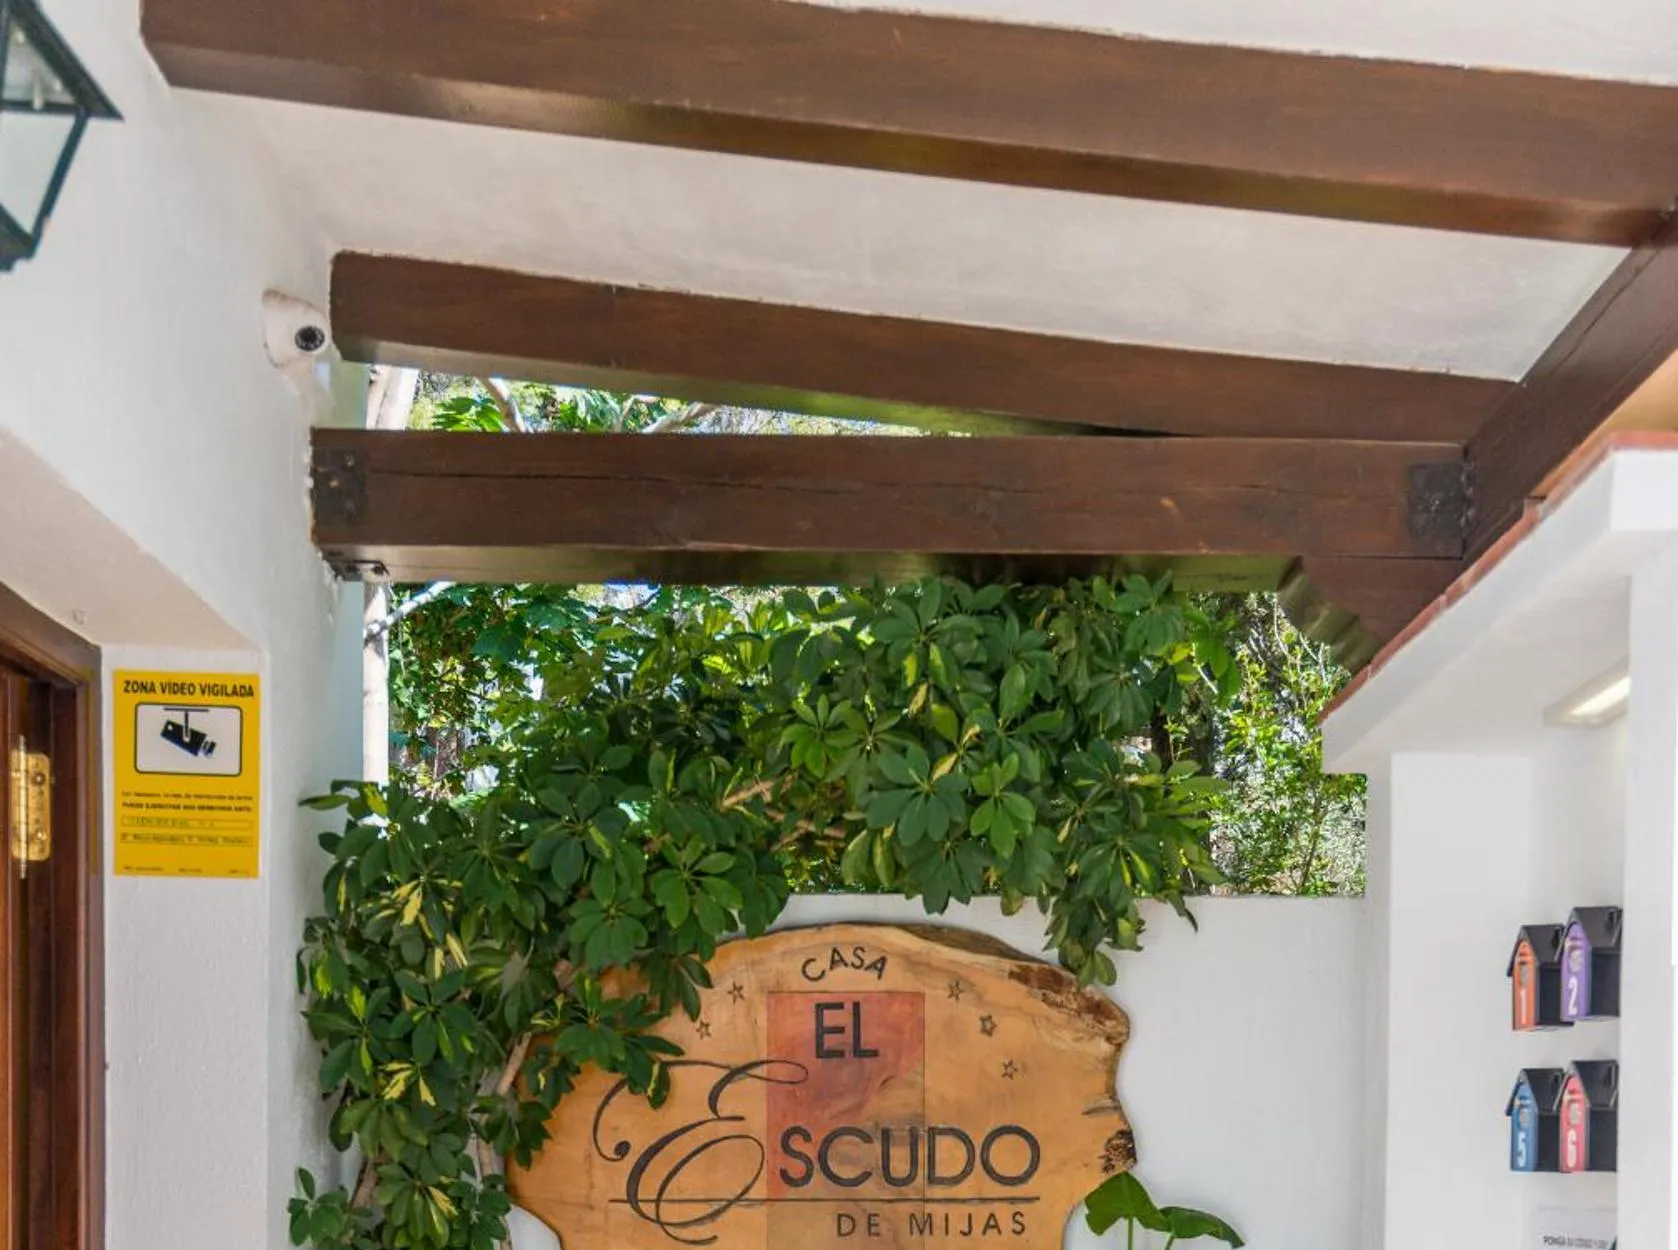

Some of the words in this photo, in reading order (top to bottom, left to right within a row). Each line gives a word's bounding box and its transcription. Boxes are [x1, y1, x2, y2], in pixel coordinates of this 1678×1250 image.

[124, 680, 156, 694] ZONA
[200, 683, 254, 698] VIGILADA
[801, 945, 887, 982] CASA
[1519, 990, 1528, 1025] 1
[1567, 976, 1577, 1015] 2
[814, 1001, 880, 1059] EL
[1517, 1133, 1526, 1168] 5
[1567, 1131, 1577, 1167] 6
[837, 1213, 880, 1237] DE
[909, 1211, 1026, 1237] MIJAS
